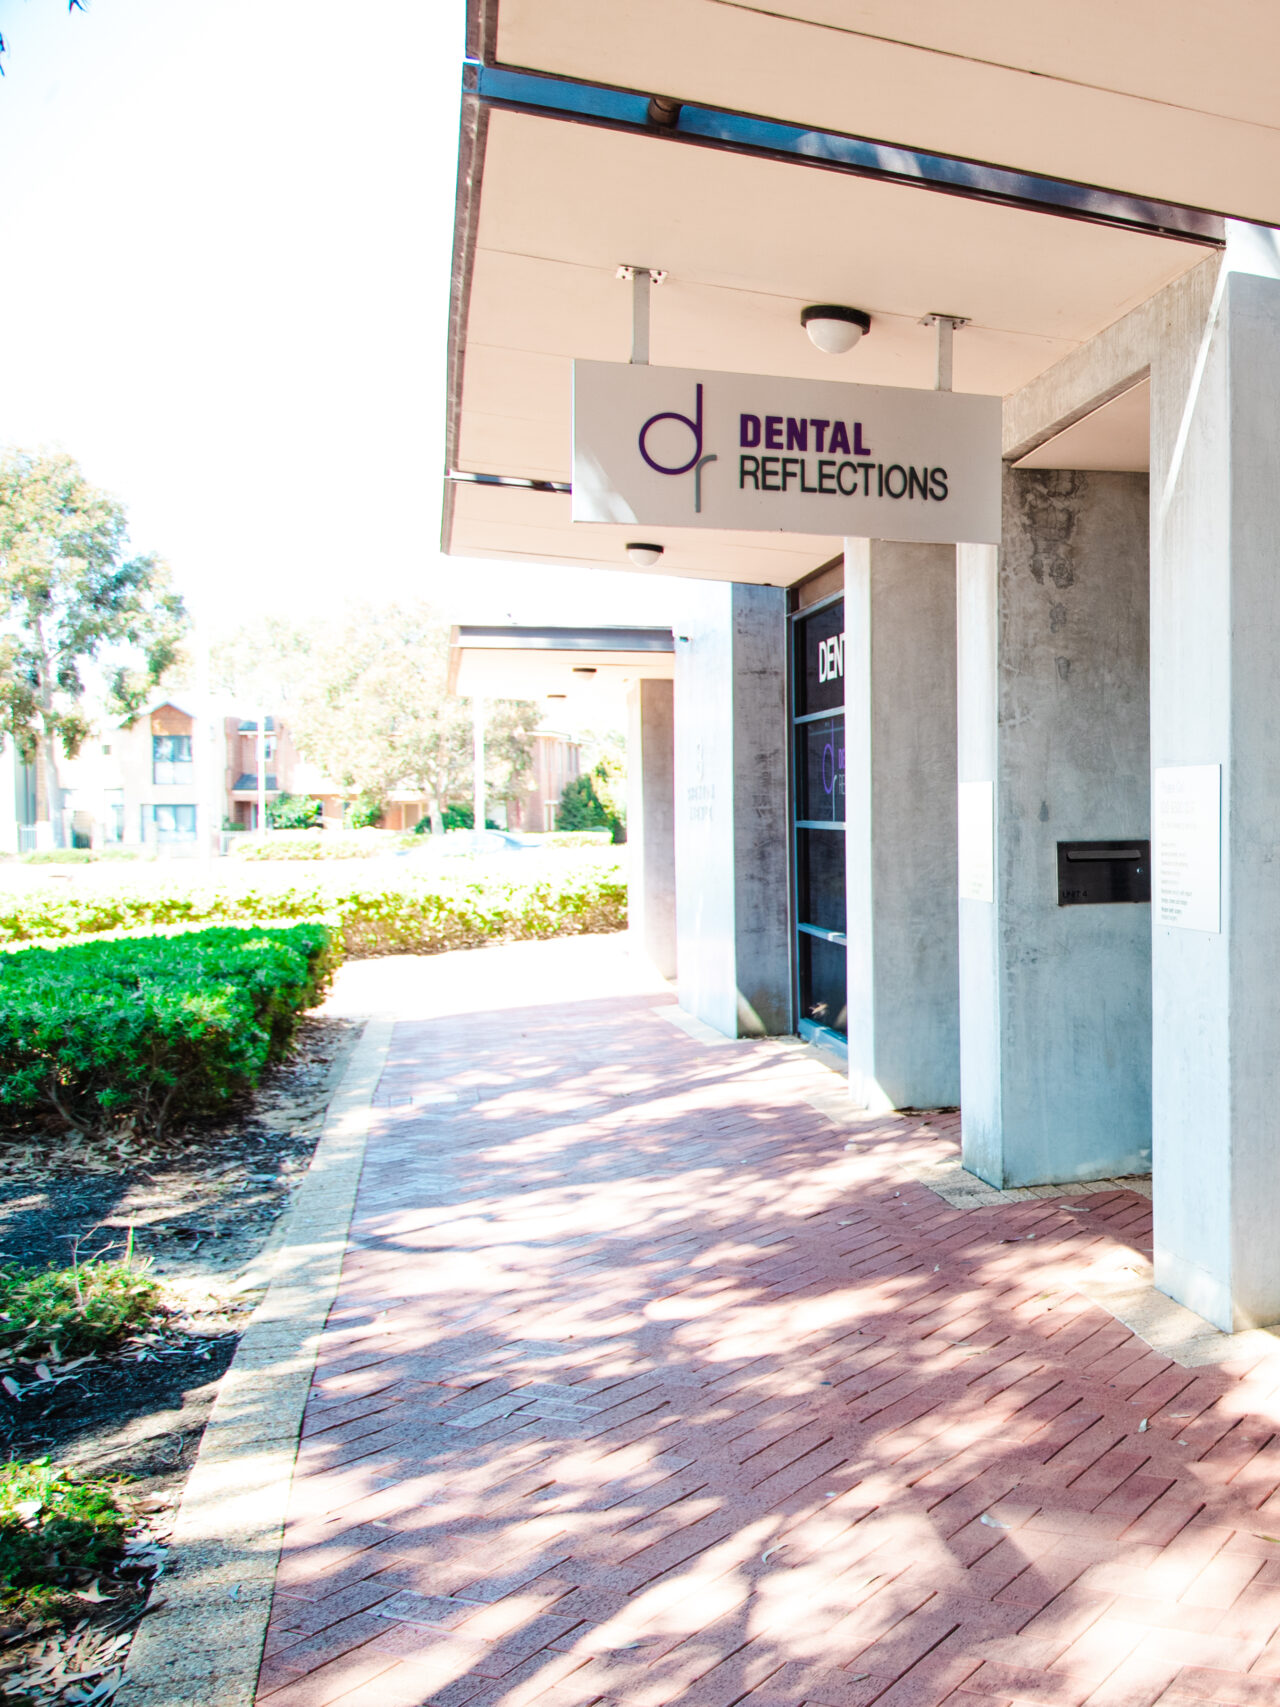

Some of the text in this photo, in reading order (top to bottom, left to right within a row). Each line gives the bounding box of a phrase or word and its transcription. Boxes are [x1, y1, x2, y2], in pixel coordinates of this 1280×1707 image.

[740, 413, 872, 456] DENTAL
[740, 455, 949, 502] REFLECTIONS
[818, 632, 845, 683] DEN
